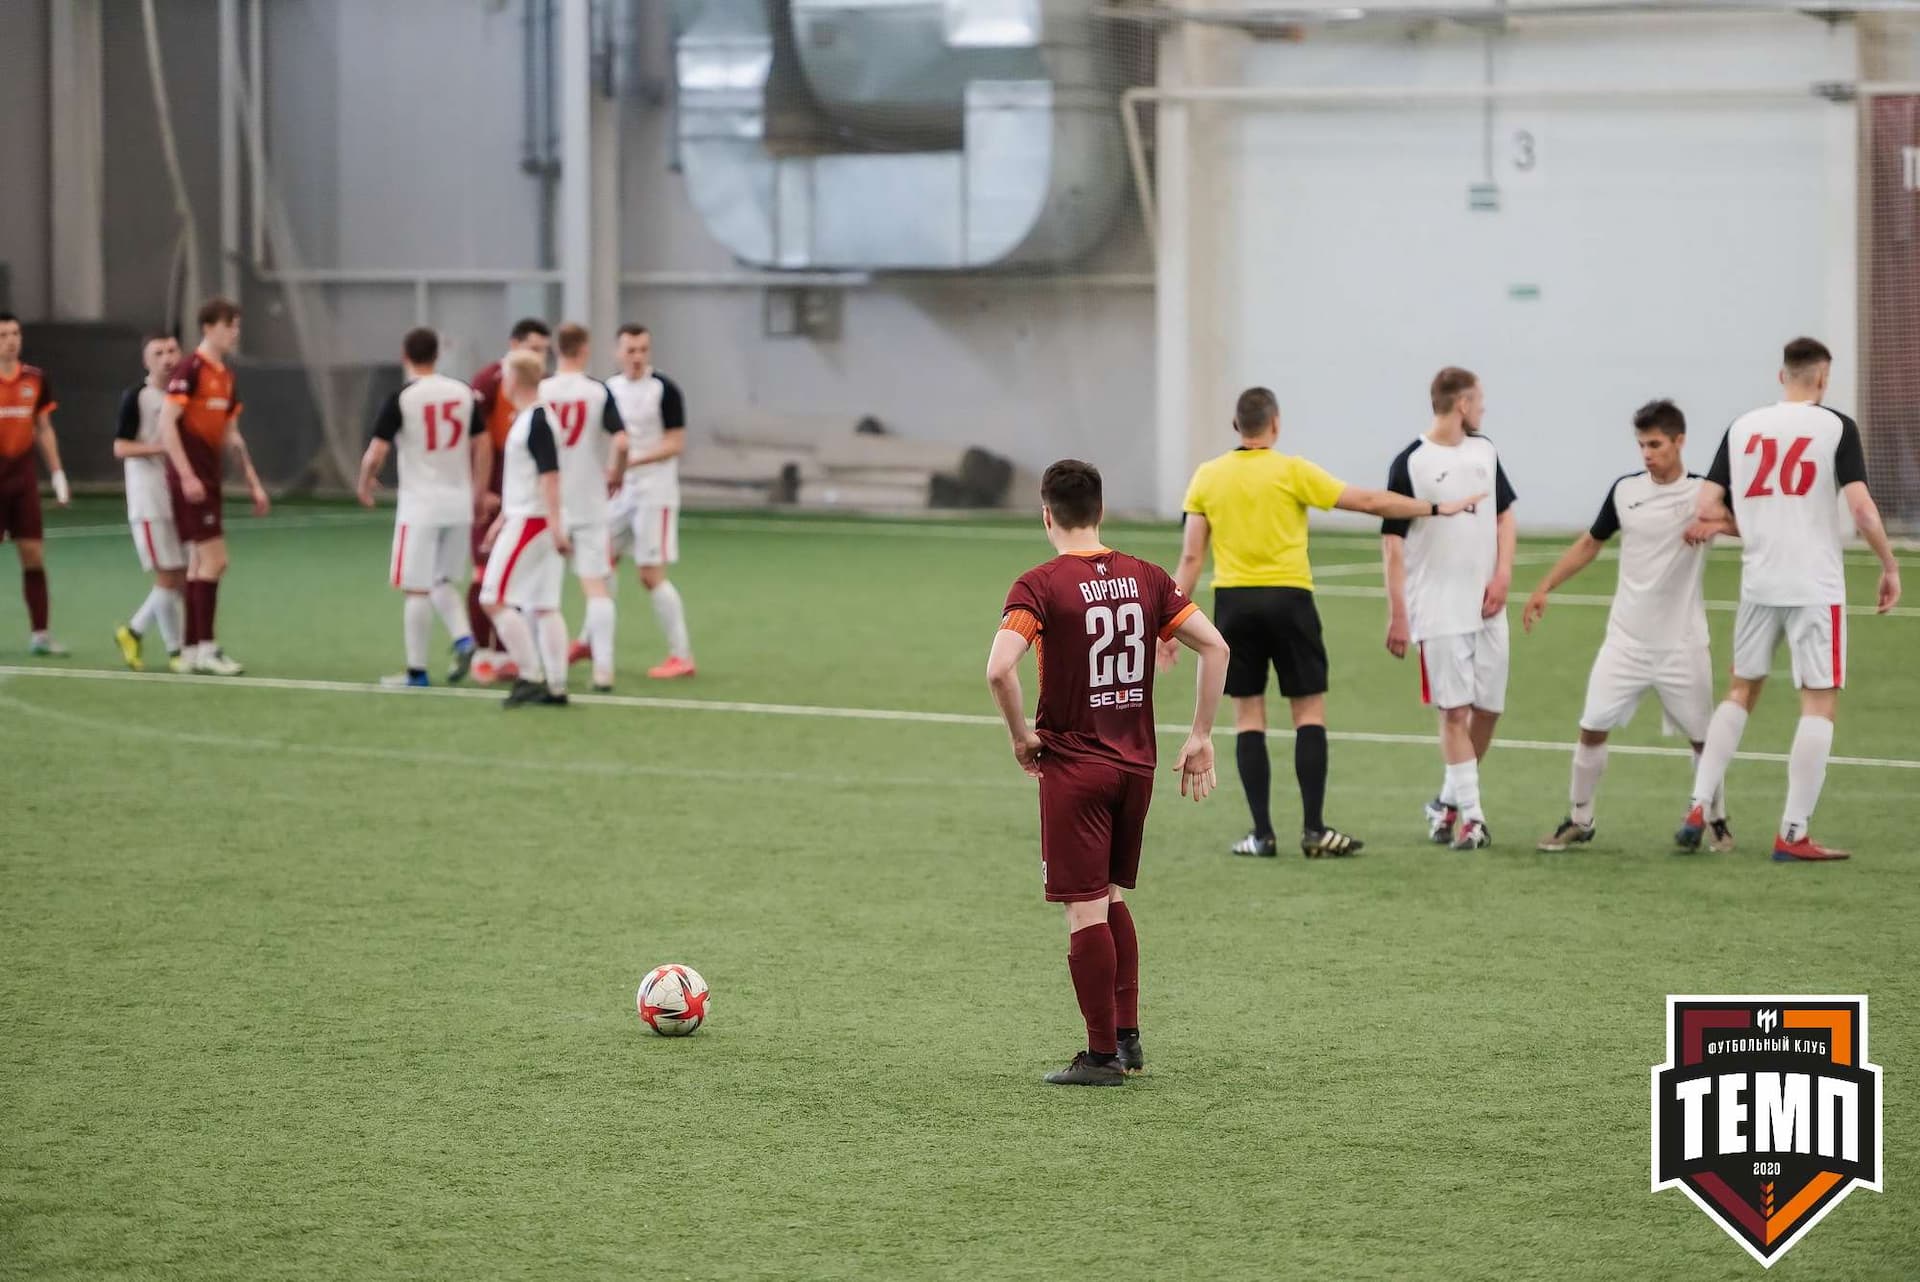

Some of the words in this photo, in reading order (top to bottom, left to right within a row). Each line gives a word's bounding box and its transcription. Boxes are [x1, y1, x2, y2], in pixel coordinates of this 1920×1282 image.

[1513, 129, 1536, 172] 3
[423, 401, 463, 451] 15
[1744, 433, 1817, 498] 26
[1079, 577, 1139, 603] ВОРОНА
[1085, 602, 1145, 688] 23
[1089, 688, 1143, 708] SEUS
